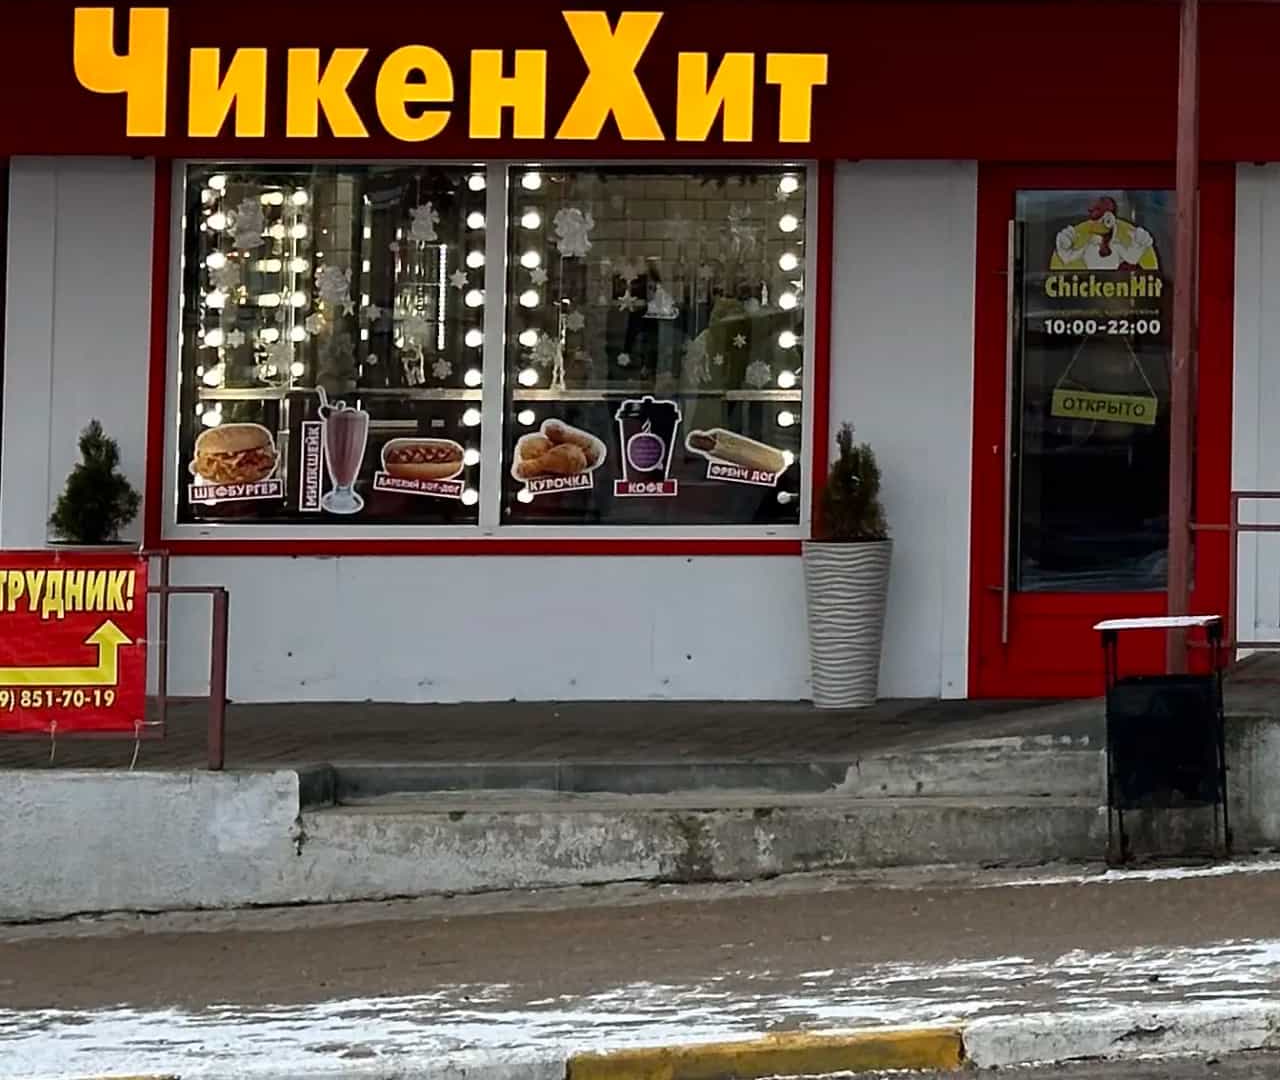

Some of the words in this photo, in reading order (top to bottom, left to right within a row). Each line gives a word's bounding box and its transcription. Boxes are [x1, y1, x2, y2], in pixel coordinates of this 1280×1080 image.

[73, 6, 829, 143] ЧикенХит
[1045, 274, 1162, 298] ChickenHit
[1044, 319, 1161, 335] 10:00-22:00
[1063, 396, 1146, 417] ОТКРЫТО
[305, 425, 321, 507] МИЛКШЕЙК
[530, 475, 590, 492] КУРОЧКА
[751, 470, 774, 482] ДОГ
[192, 482, 279, 499] ШЕФБУРГЕР
[628, 482, 664, 494] КОФЕ
[20, 689, 115, 708] 851-70-19
